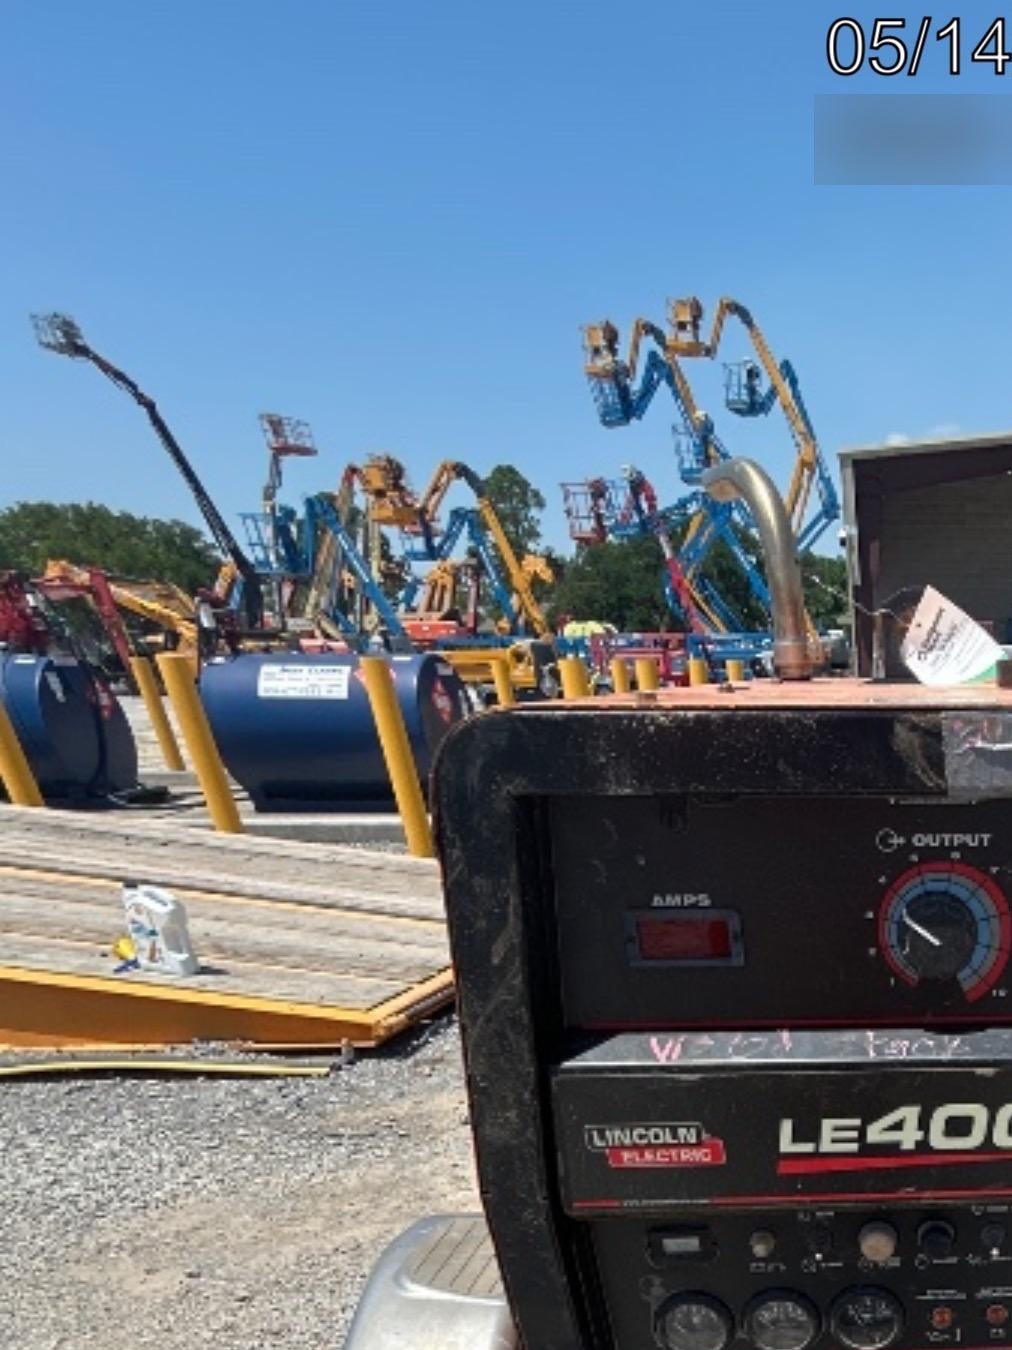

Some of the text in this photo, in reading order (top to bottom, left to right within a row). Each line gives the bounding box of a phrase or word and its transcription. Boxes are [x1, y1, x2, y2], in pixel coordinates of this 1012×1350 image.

[912, 833, 992, 847] OUTPUT
[651, 892, 711, 907] AMPS
[592, 1127, 698, 1146] LINCOLN
[620, 1148, 712, 1163] ELECTRIC
